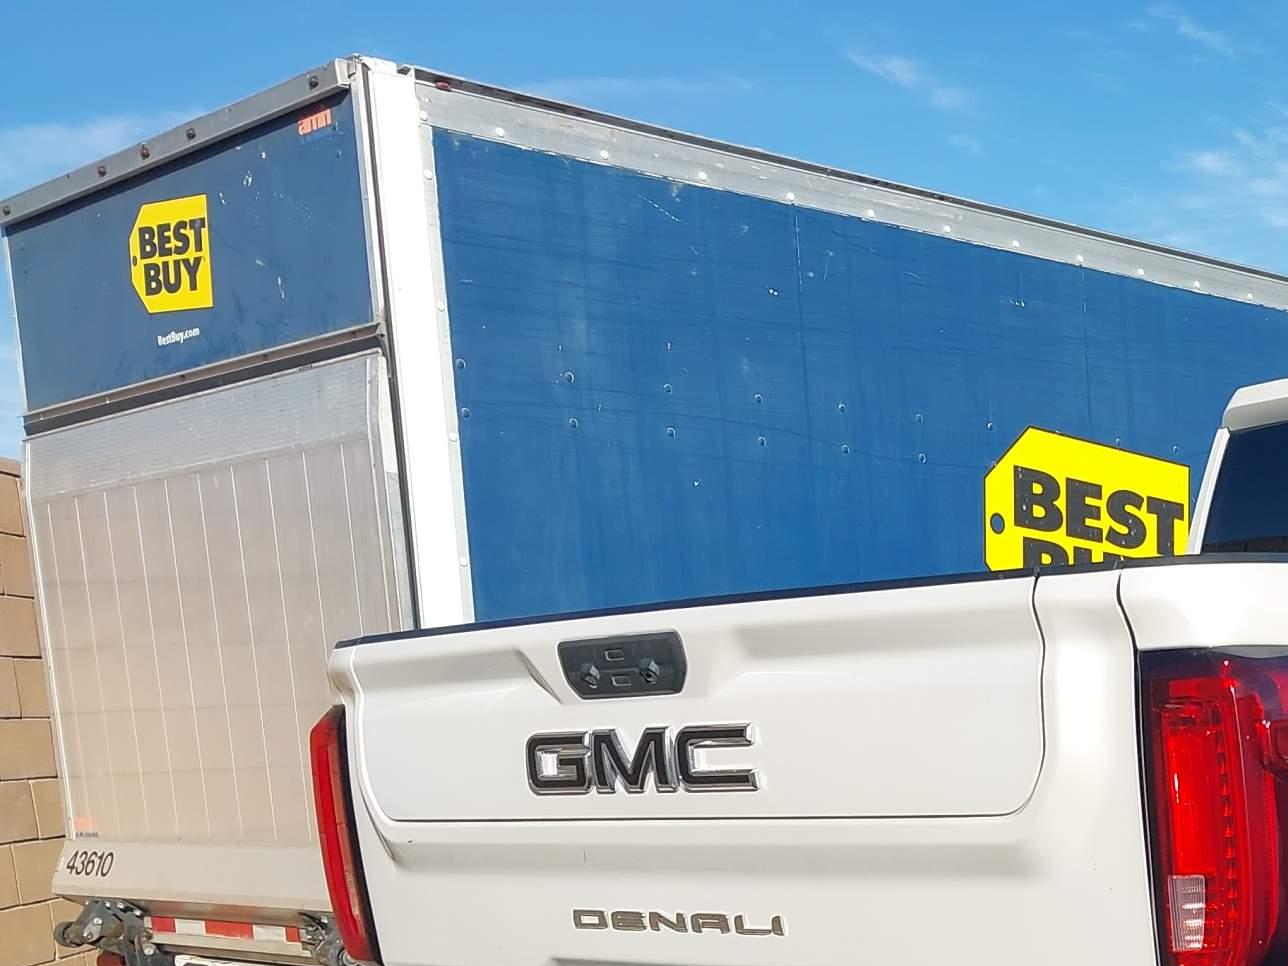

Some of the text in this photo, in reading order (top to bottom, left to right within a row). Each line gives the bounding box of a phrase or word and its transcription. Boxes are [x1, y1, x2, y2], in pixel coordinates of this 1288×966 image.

[138, 217, 206, 260] BEST
[143, 255, 203, 296] BUY
[157, 326, 200, 346] BestBuy.com
[1013, 464, 1185, 557] BEST
[525, 722, 760, 796] GMC
[66, 850, 114, 877] 43610
[572, 908, 786, 937] DENALI
